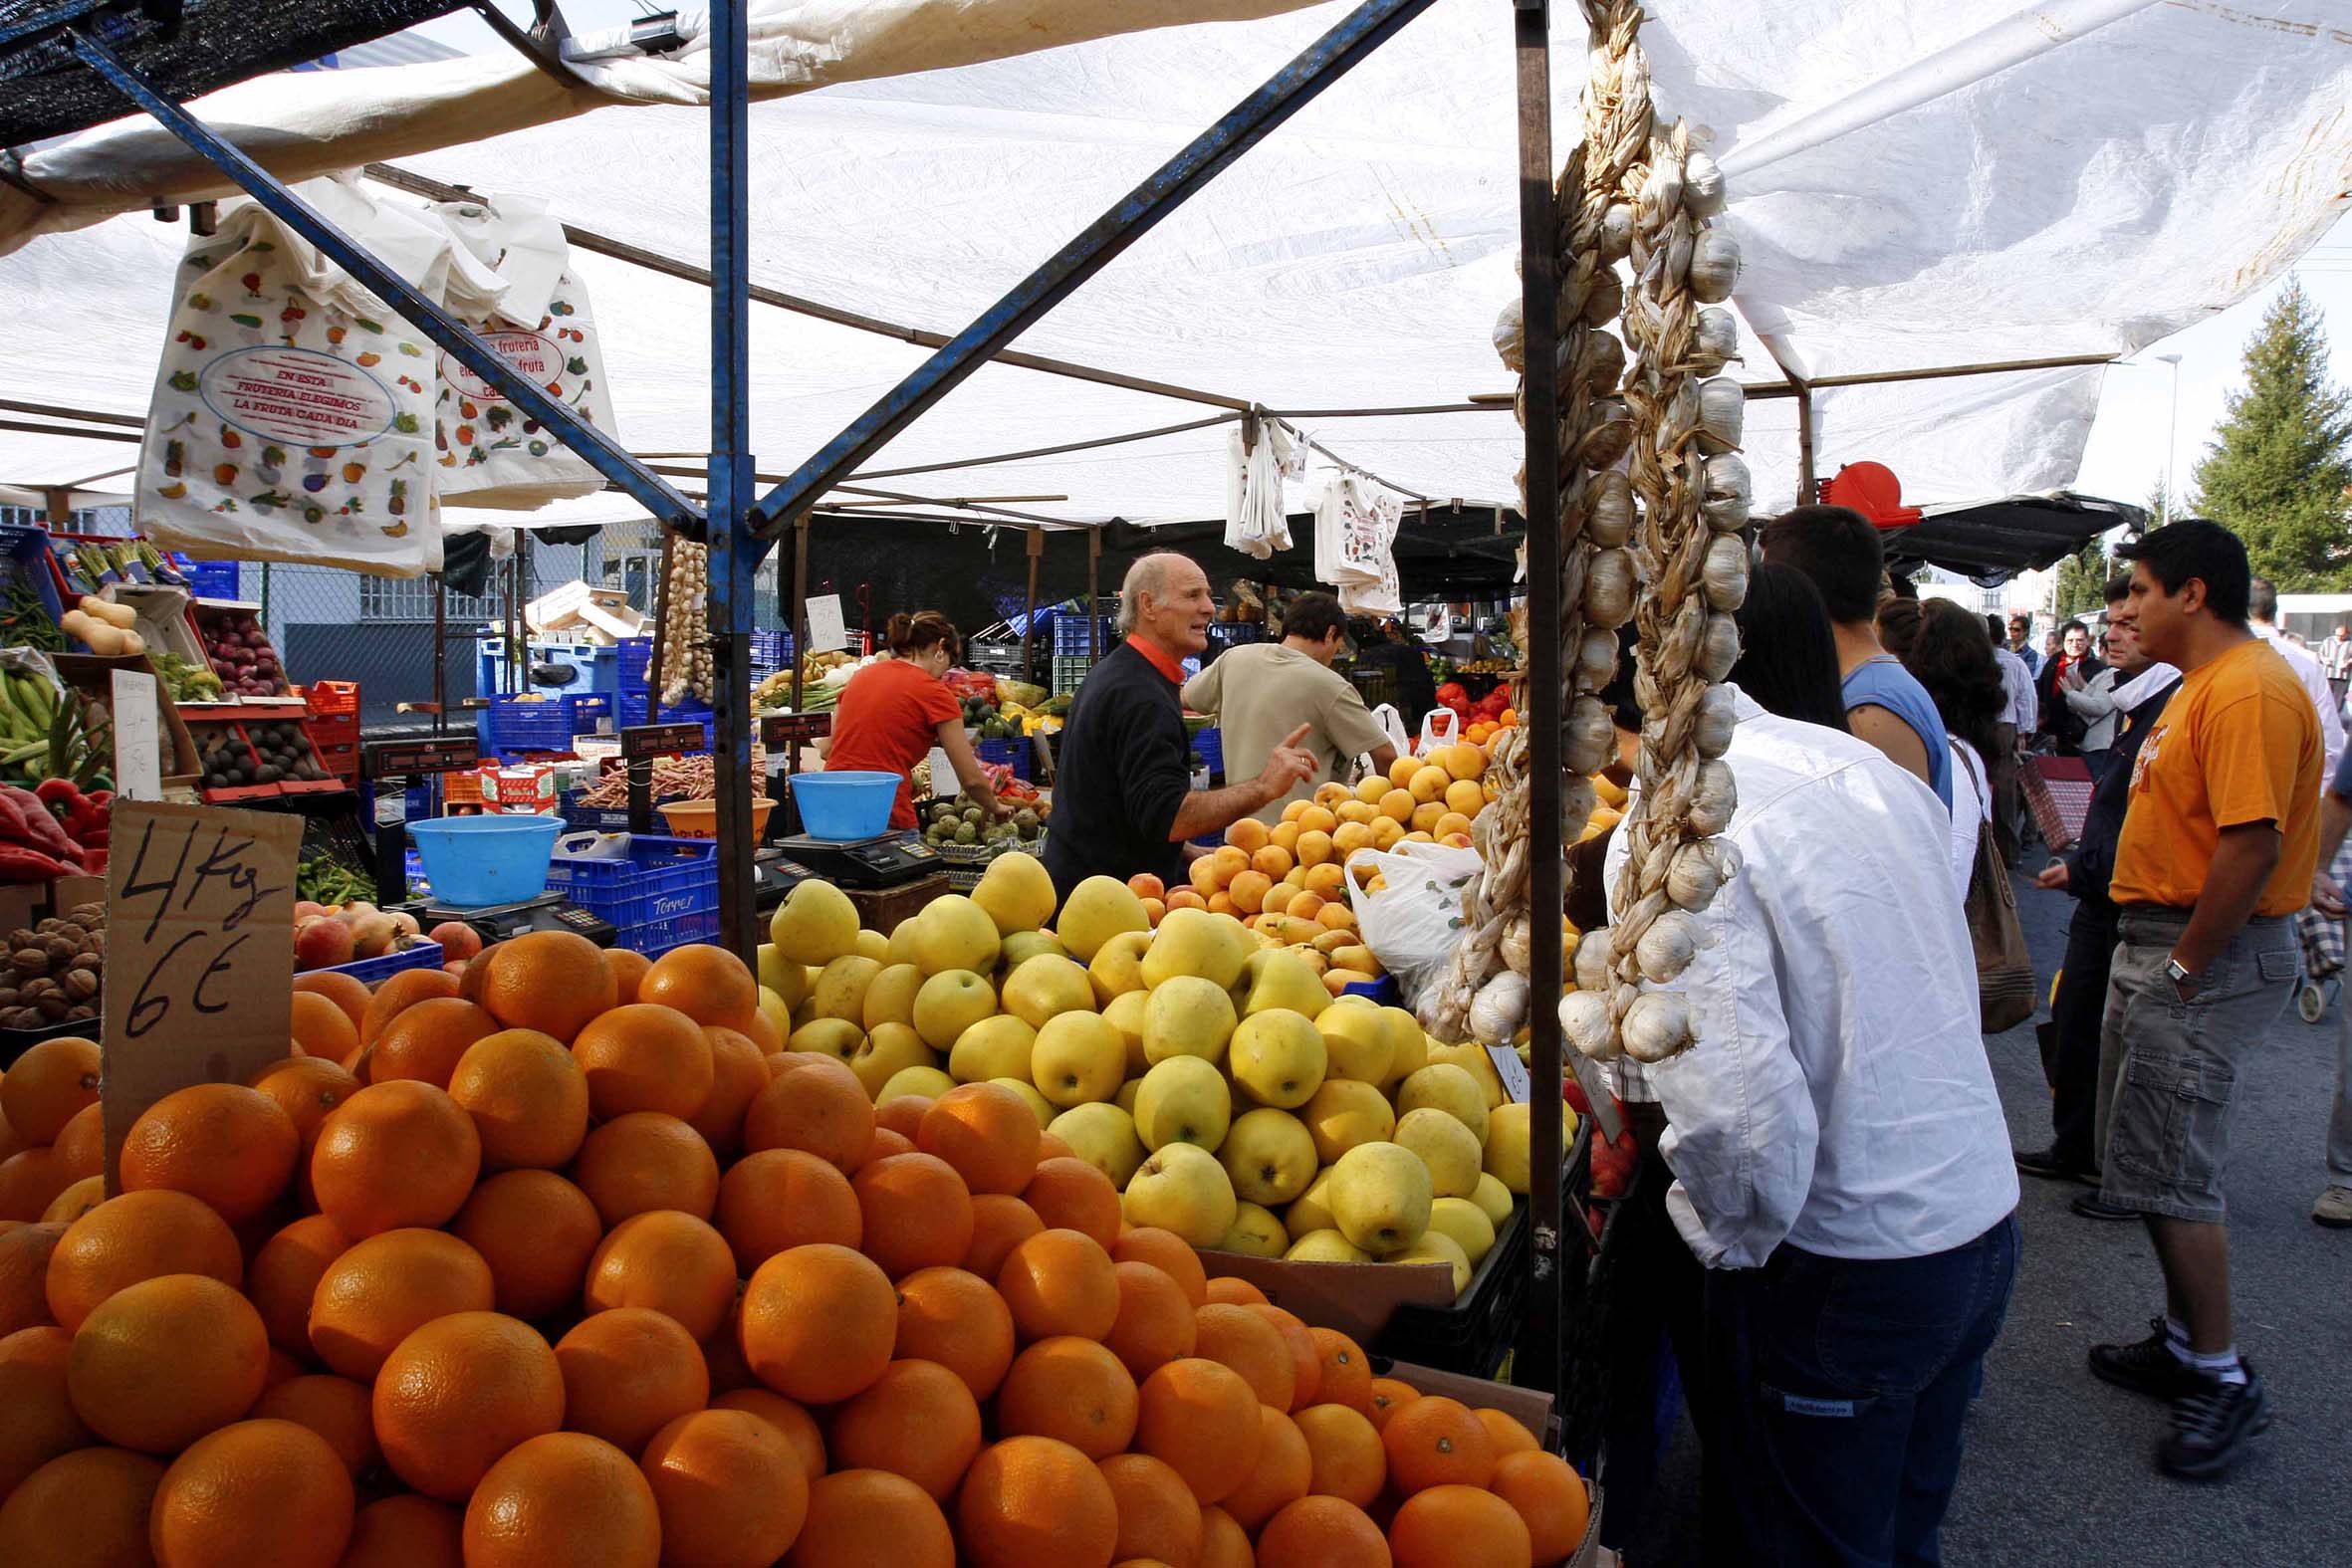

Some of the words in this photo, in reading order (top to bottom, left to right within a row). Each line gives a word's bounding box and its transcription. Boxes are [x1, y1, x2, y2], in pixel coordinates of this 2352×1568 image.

[519, 358, 545, 372] fruta
[278, 370, 295, 380] EN
[298, 374, 327, 386] ESTA
[234, 399, 250, 409] LA
[253, 402, 293, 416] FRUTA
[300, 392, 360, 411] ELEGIMOS
